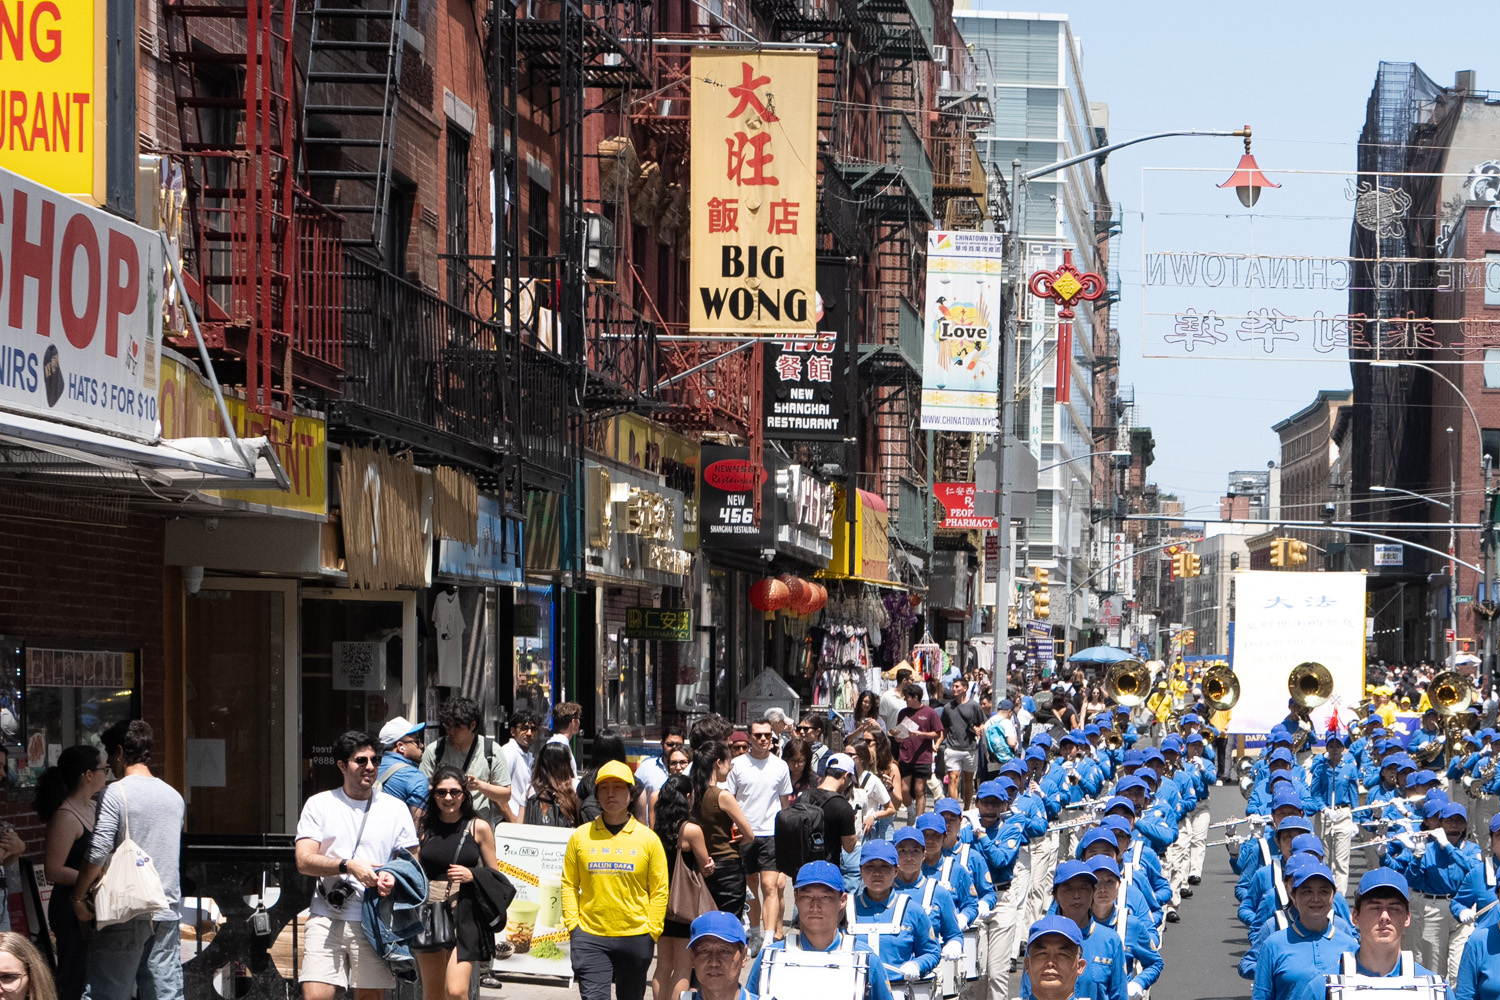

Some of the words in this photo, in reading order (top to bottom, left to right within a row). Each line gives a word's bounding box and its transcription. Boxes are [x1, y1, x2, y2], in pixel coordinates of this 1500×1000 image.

[727, 61, 780, 187] 大旺
[707, 198, 800, 235] 飯店
[721, 245, 784, 279] BIG
[0, 188, 140, 358] HOP
[699, 287, 807, 322] WONG
[942, 323, 987, 339] Love
[775, 354, 834, 382] 餐館
[68, 373, 98, 407] HATS
[101, 380, 108, 408] 3
[110, 385, 134, 416] FOR
[137, 391, 156, 422] $10
[790, 388, 814, 400] NEW
[774, 402, 830, 415] SHANGHAI
[767, 416, 839, 430] RESTAURANT
[922, 414, 996, 428] WWW.CHINATOWN.NYC
[727, 495, 746, 506] NEW
[719, 508, 753, 524] 456
[950, 508, 974, 516] PEOP
[945, 519, 993, 528] PHARMACY
[1263, 595, 1338, 609] 大法
